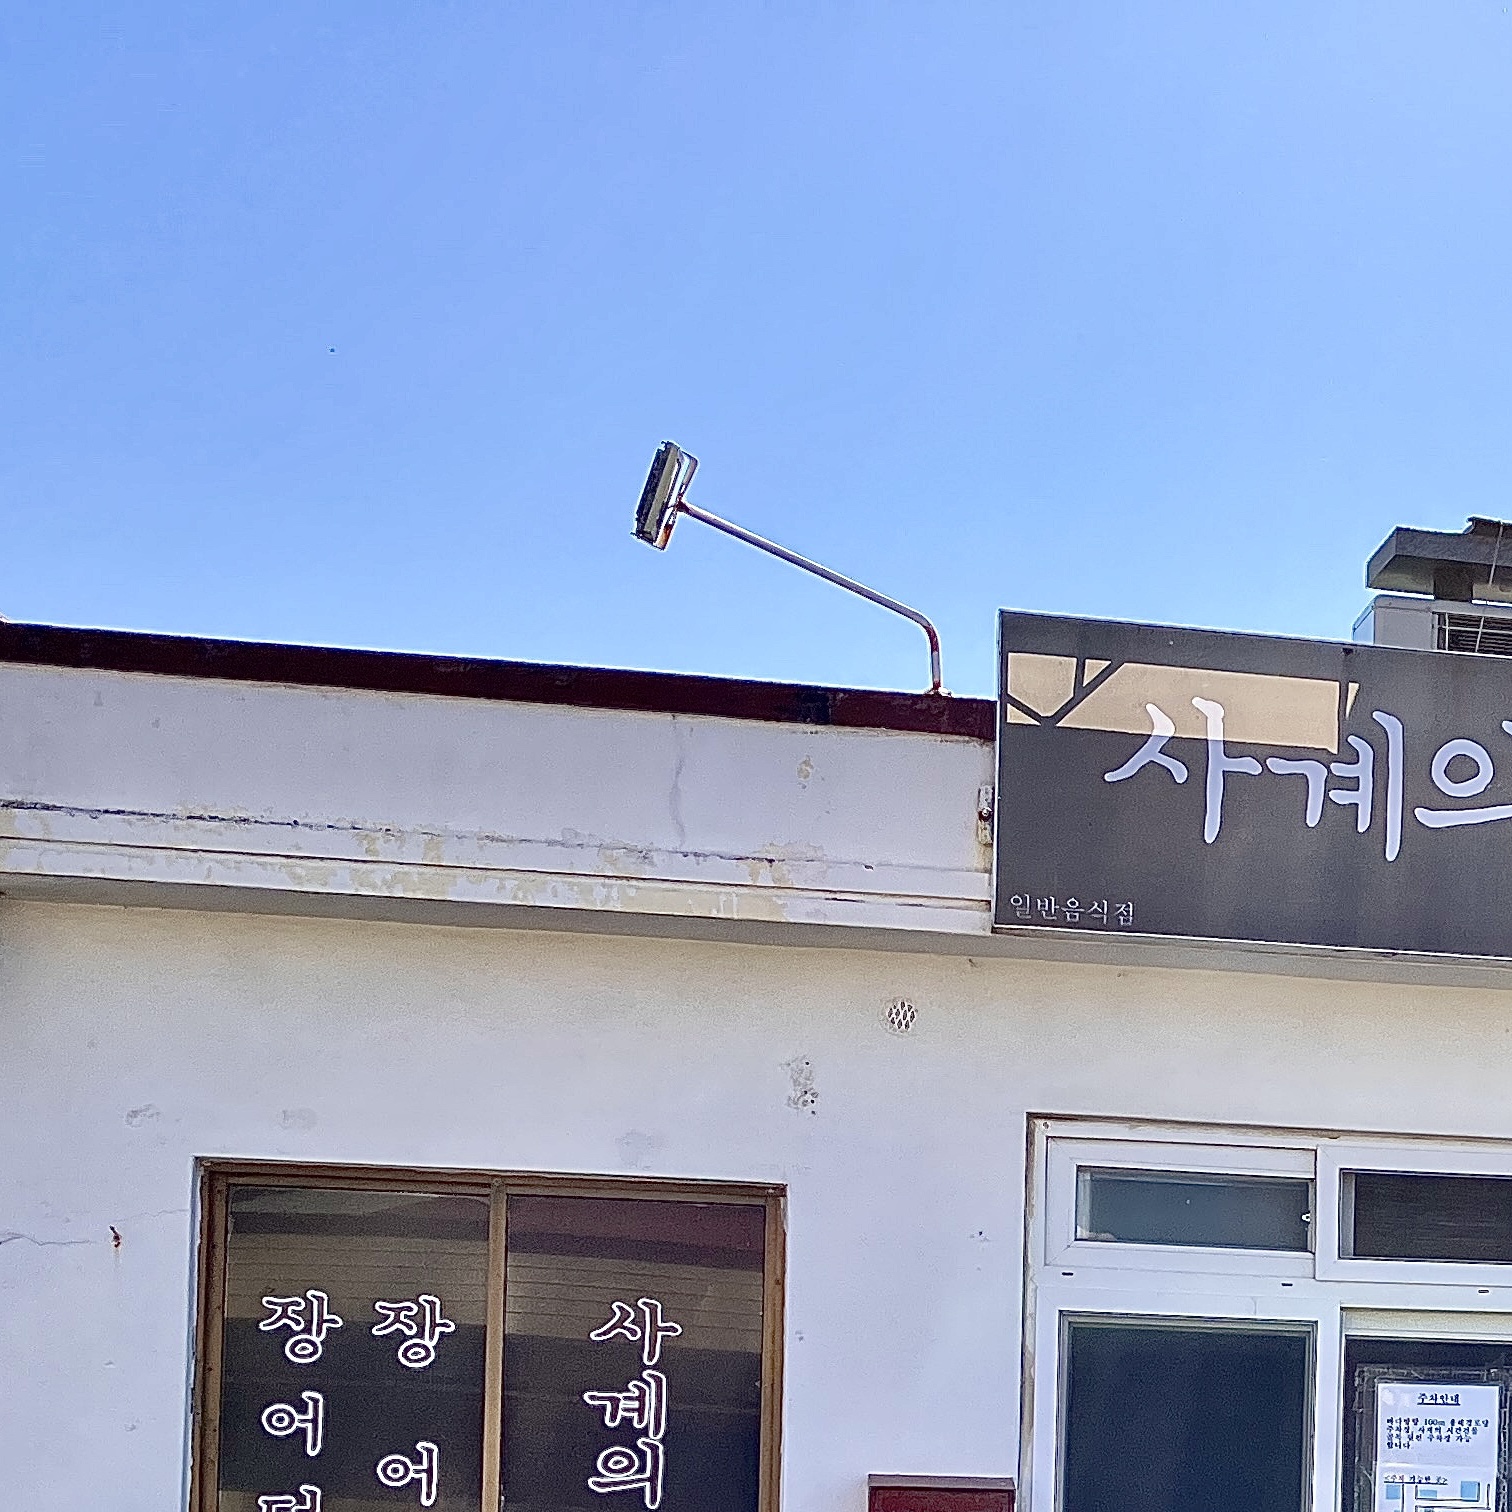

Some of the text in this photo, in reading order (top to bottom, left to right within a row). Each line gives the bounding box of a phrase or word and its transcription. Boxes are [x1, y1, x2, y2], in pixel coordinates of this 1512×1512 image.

[1009, 893, 1136, 926] 일반음식점
[583, 1298, 682, 1509] 사계의
[1417, 1393, 1460, 1404] 주차안내
